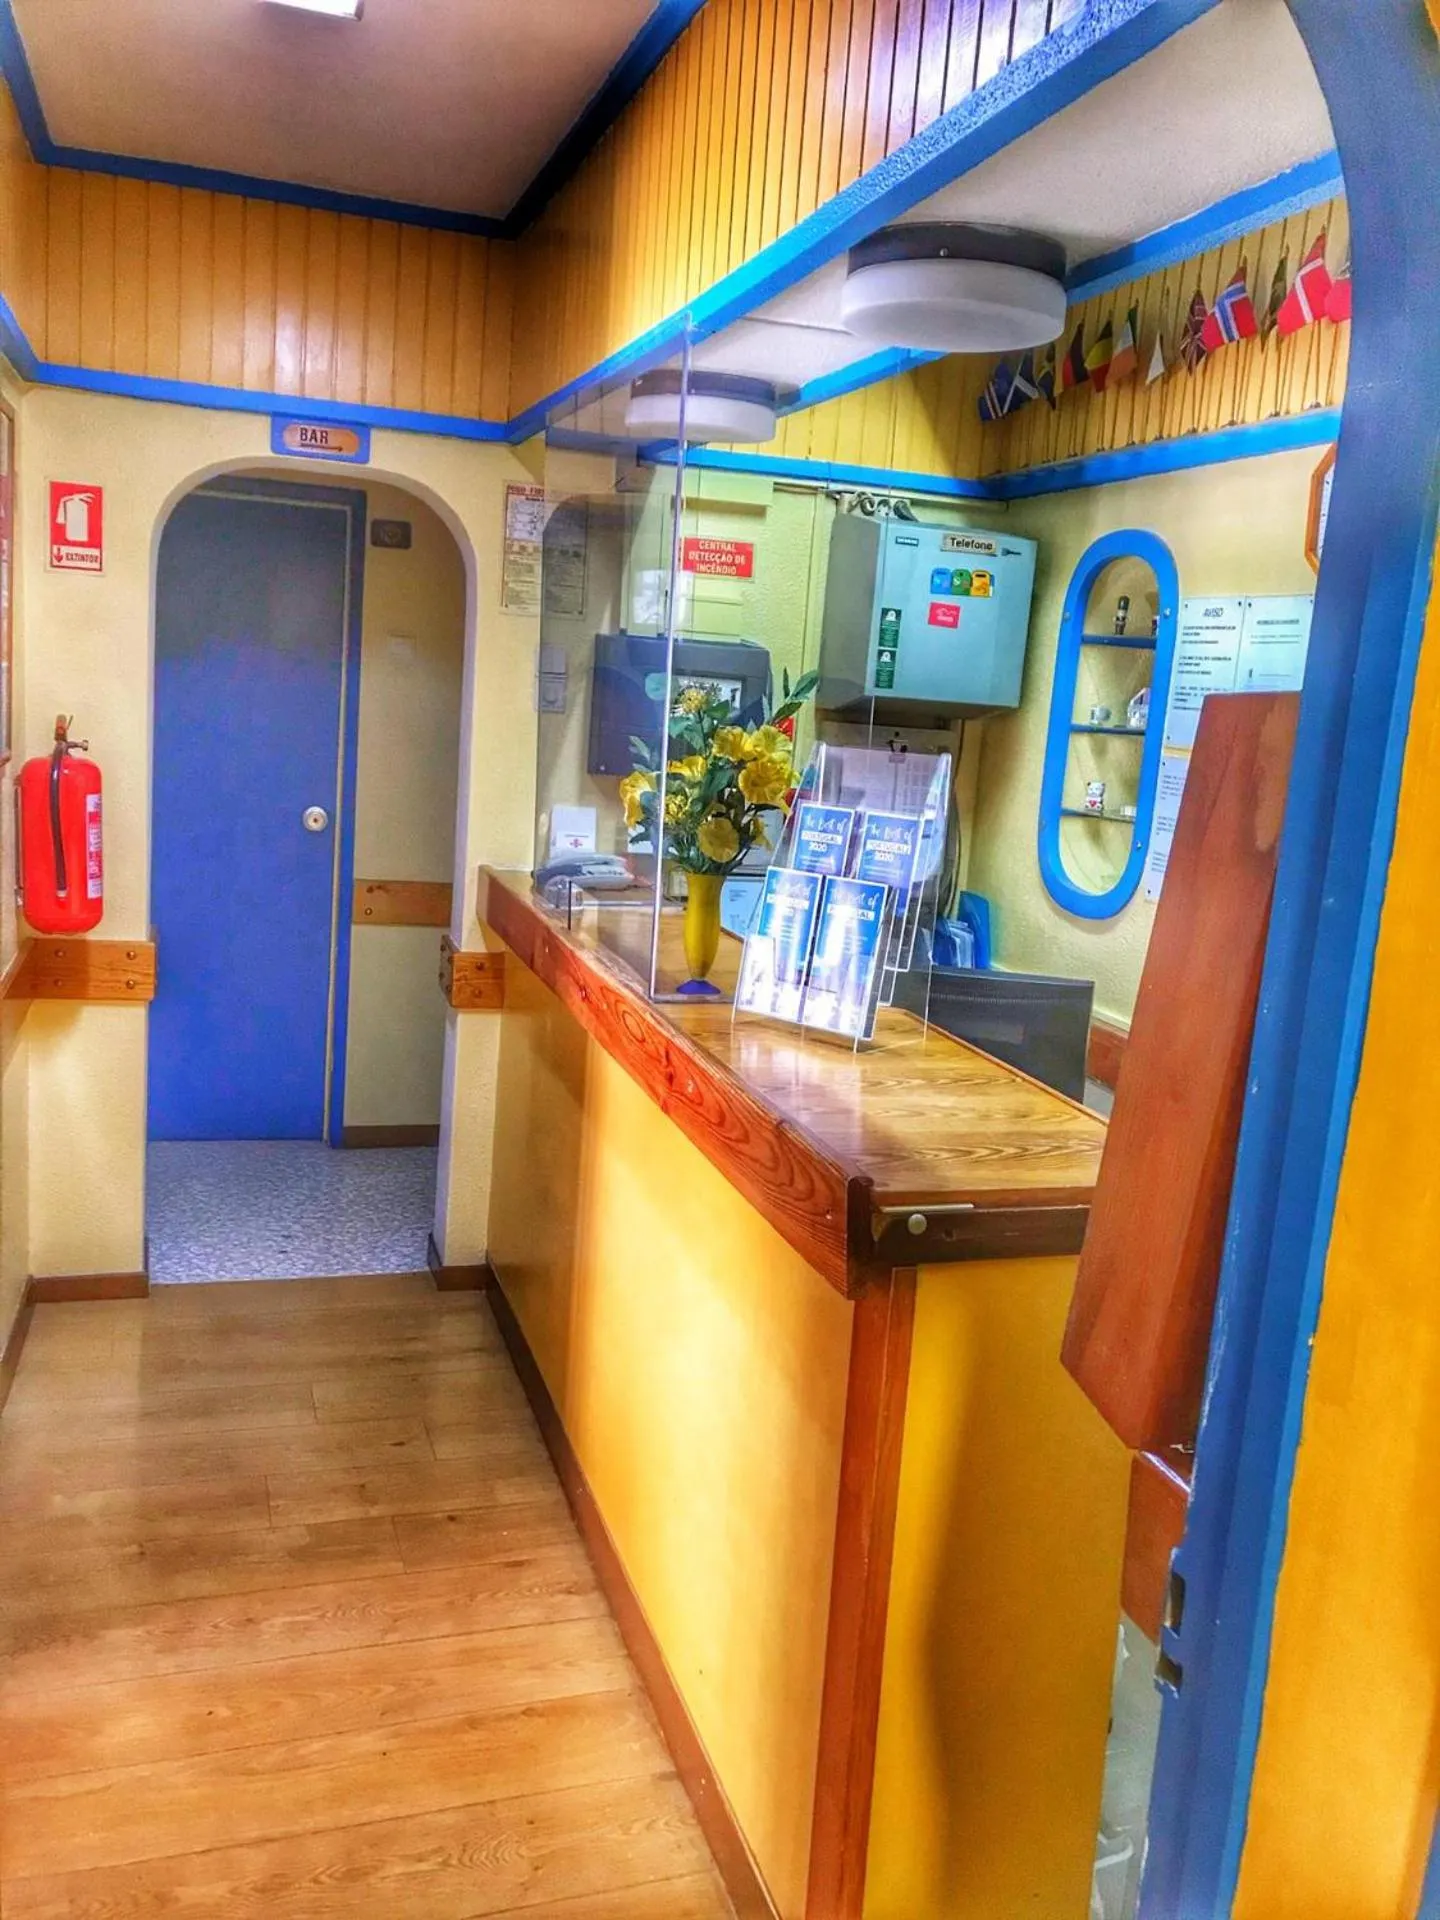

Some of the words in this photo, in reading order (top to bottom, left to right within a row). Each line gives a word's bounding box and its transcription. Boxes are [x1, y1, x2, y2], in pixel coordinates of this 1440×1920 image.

[300, 427, 328, 444] BAR
[698, 540, 736, 552] CENTRAL
[951, 537, 993, 550] Telefone
[688, 551, 733, 564] DETECÇÃO
[735, 554, 746, 565] DE
[696, 563, 737, 575] INCÊNDIO
